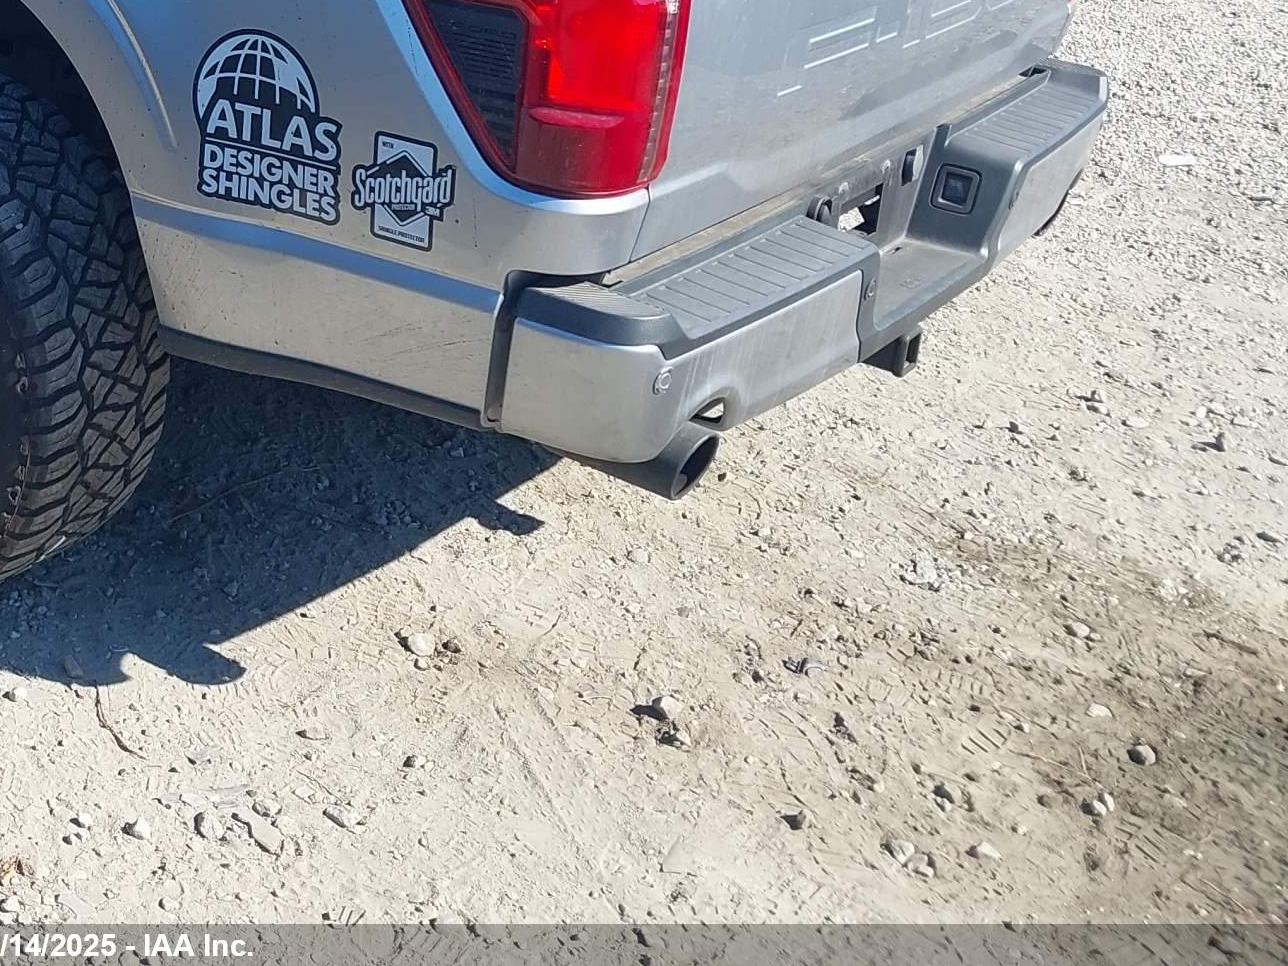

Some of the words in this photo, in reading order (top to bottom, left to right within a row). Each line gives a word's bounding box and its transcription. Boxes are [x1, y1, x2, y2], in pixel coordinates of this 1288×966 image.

[206, 98, 340, 162] ATLAS
[201, 170, 337, 222] SHINGLES
[203, 144, 336, 197] DESIGNER
[354, 168, 453, 213] Scotchgard
[424, 205, 441, 218] 3M
